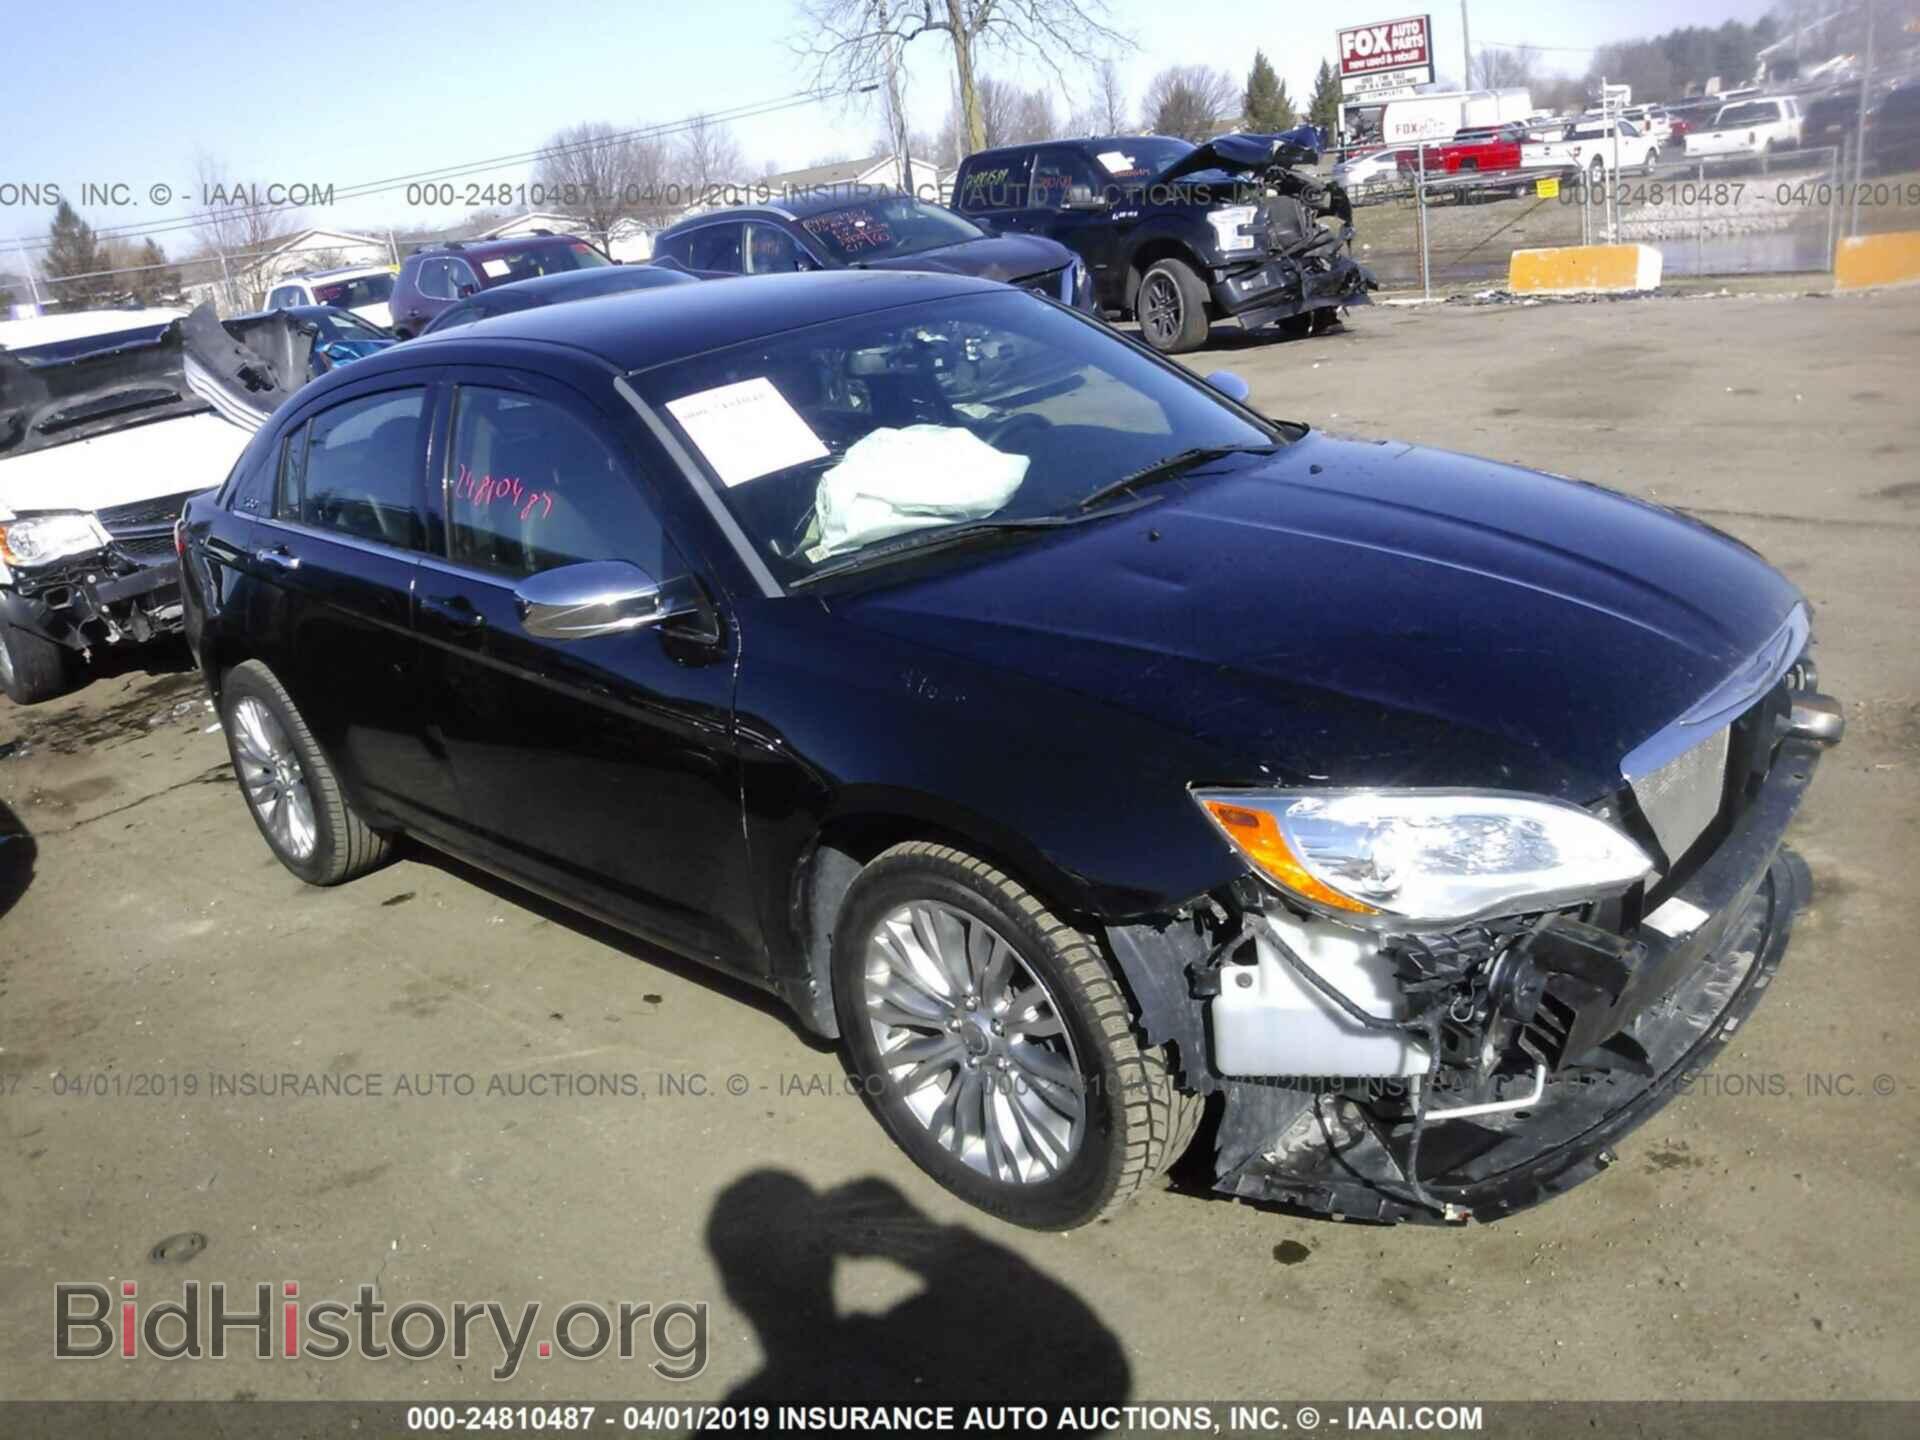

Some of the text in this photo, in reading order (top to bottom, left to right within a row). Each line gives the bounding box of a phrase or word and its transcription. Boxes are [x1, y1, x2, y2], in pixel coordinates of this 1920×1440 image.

[1392, 21, 1420, 37] AUTO
[1341, 27, 1391, 59] FOX
[1392, 34, 1424, 52] PARTS
